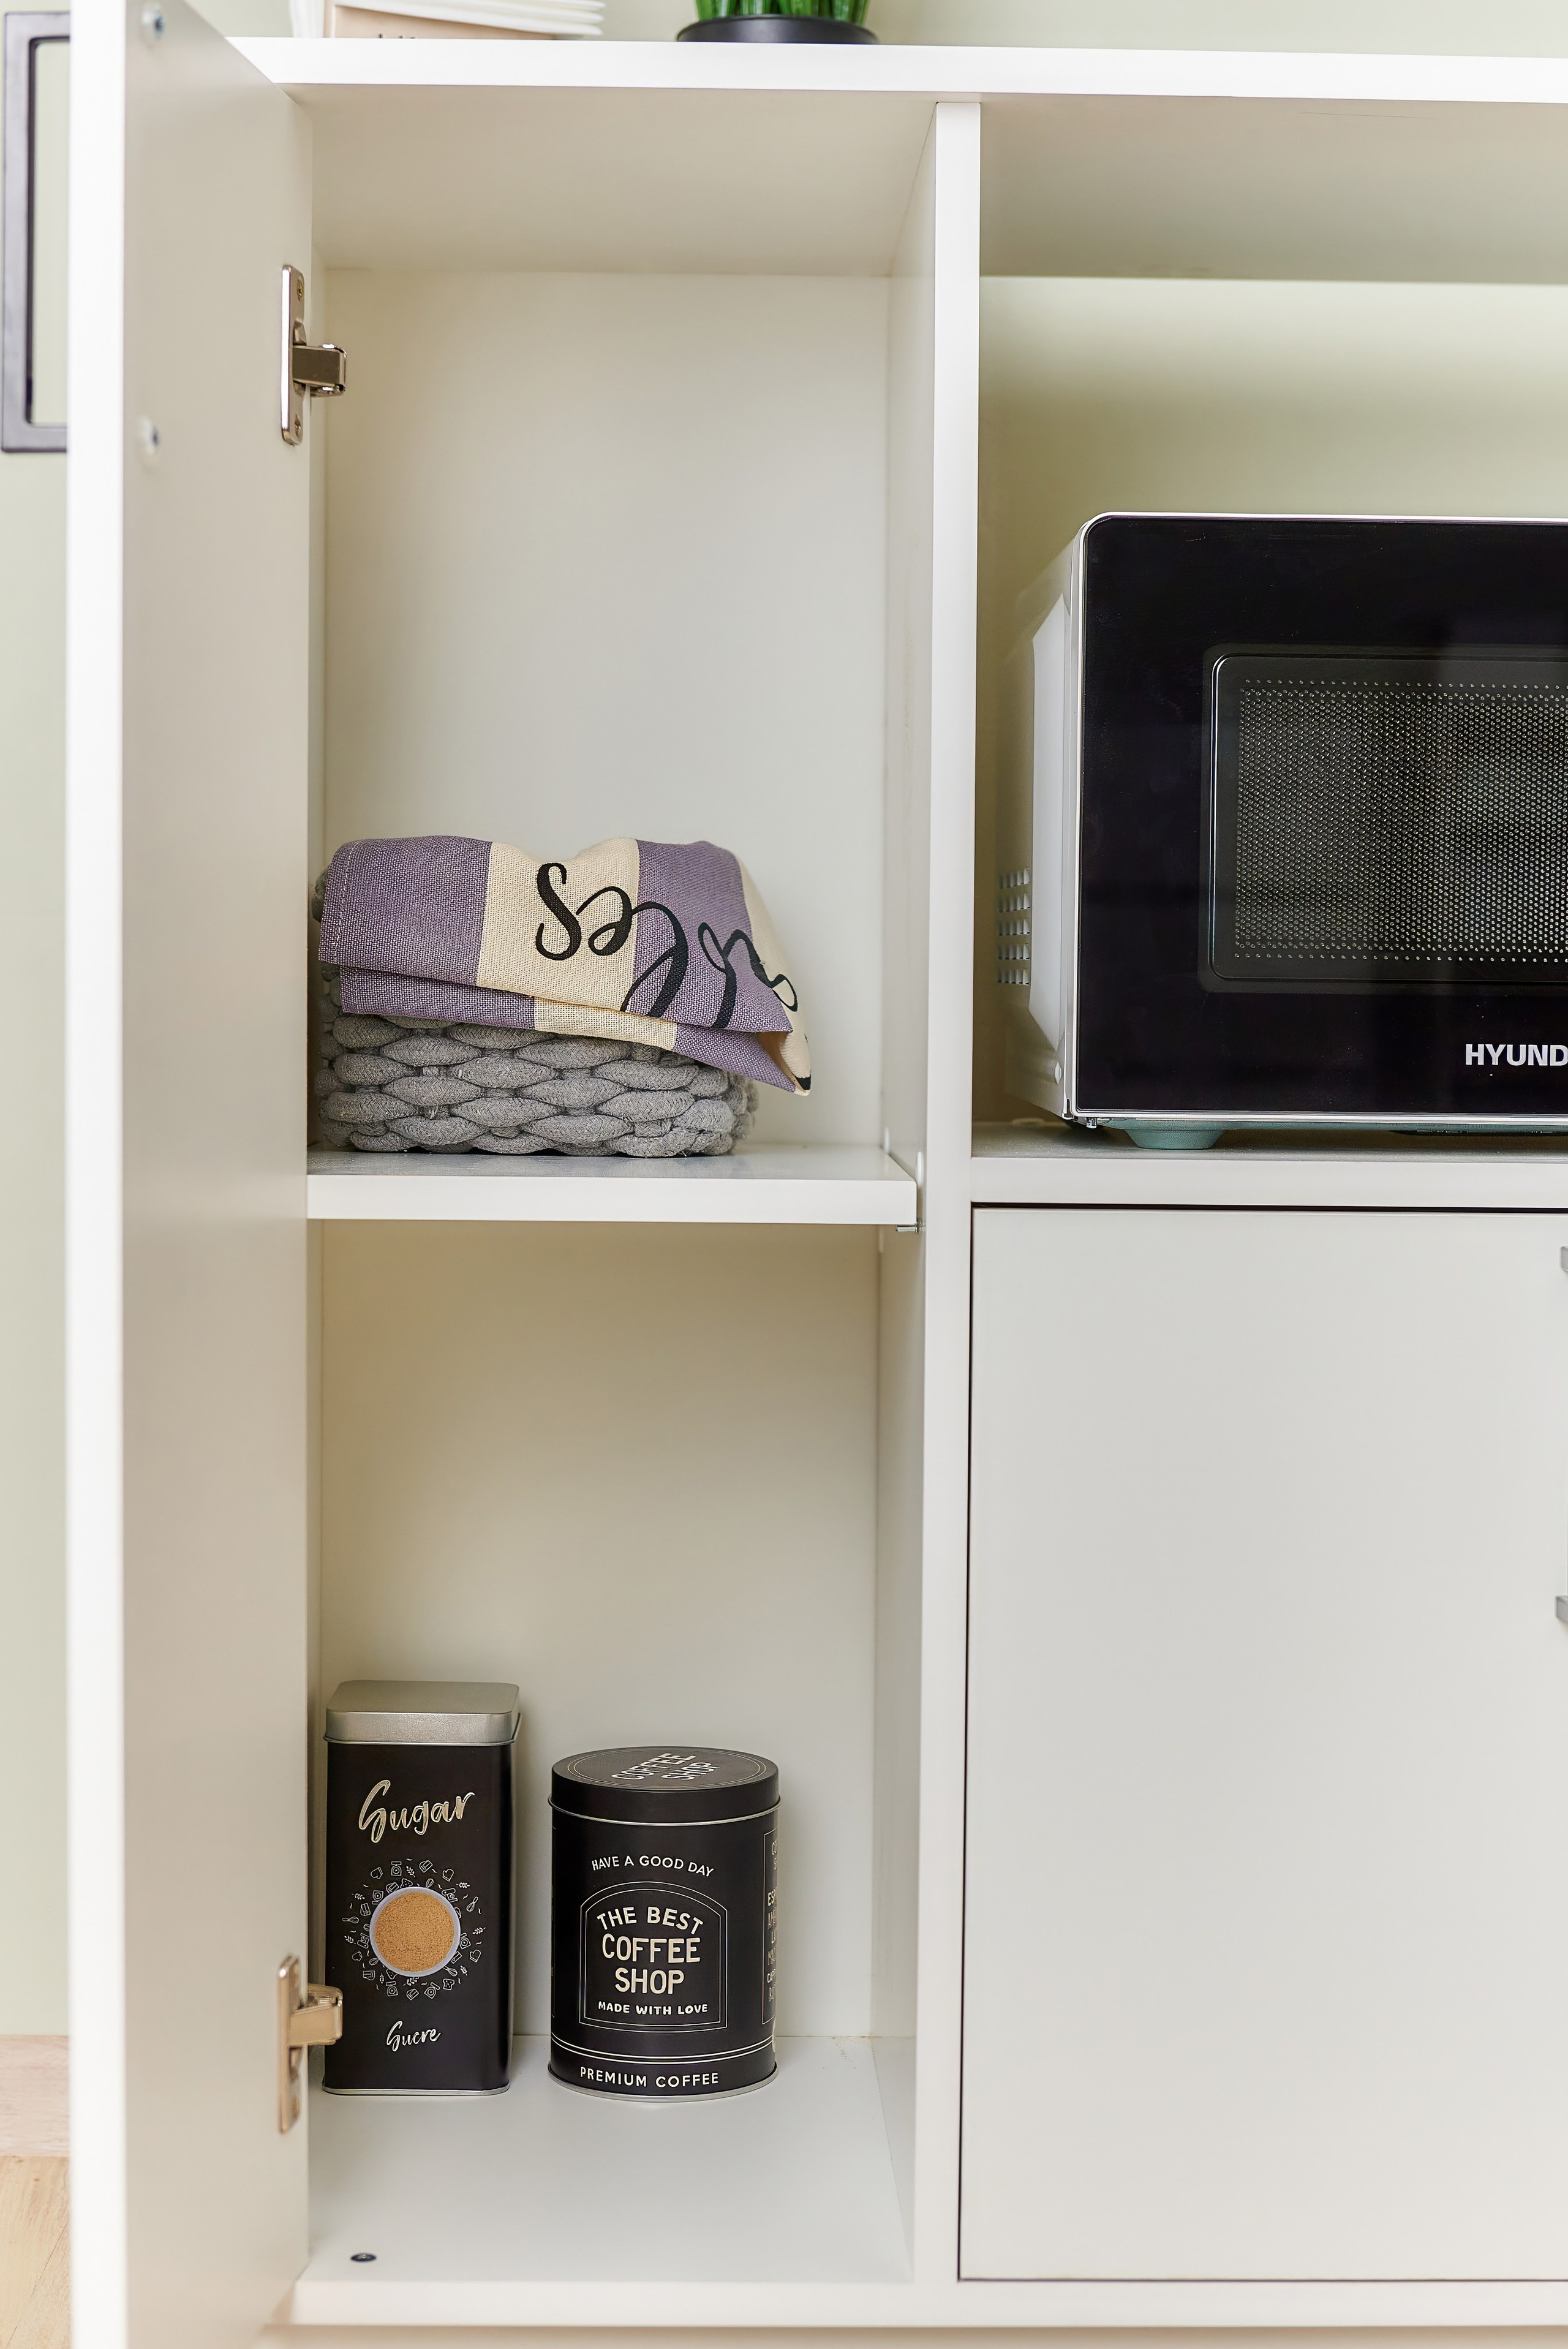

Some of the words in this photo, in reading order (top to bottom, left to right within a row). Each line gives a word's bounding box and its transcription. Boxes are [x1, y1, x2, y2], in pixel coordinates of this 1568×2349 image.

[1465, 1044, 1568, 1066] HYUND
[611, 1752, 697, 1781] COFFEE
[661, 1762, 721, 1781] SHOP
[358, 1779, 476, 1844] Sugar
[592, 1856, 620, 1871] HAVE
[624, 1855, 635, 1866] A
[639, 1855, 684, 1869] GOOD
[687, 1861, 714, 1877] DAY
[597, 1906, 637, 1930] THE
[647, 1906, 704, 1935] BEST
[602, 1933, 701, 1963] COFFEE
[615, 1967, 685, 1994] SHOP
[598, 2000, 630, 2013] MADE
[636, 2004, 672, 2015] WITH
[677, 2004, 708, 2015] LOVE
[386, 2021, 441, 2052] Sucre
[580, 2066, 647, 2087] PREMIUM
[655, 2072, 718, 2088] COFFEE
